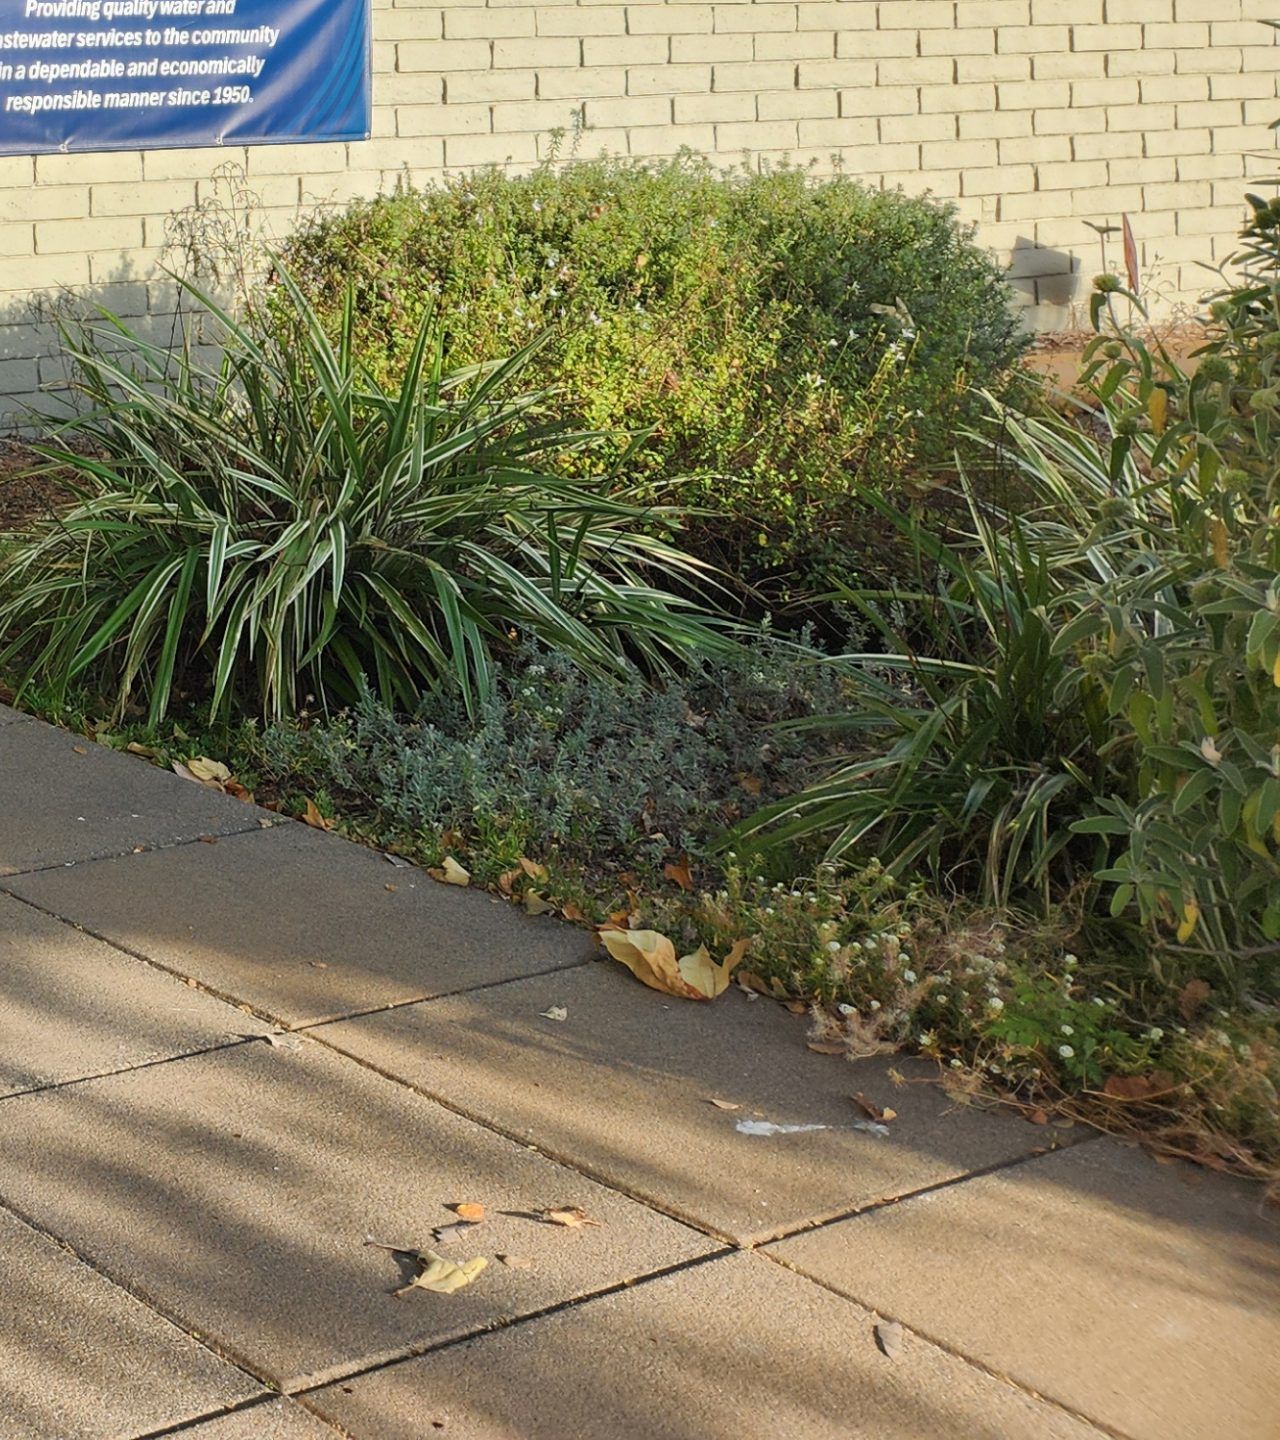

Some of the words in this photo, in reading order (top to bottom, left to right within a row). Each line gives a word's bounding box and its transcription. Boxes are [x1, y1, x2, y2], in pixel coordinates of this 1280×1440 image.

[76, 28, 142, 47] services
[145, 29, 161, 45] to
[164, 27, 189, 45] the
[191, 25, 280, 47] community
[15, 64, 26, 80] a
[28, 59, 125, 83] dependable
[127, 58, 159, 77] and
[160, 55, 266, 78] economically
[6, 90, 102, 115] responsible
[103, 91, 167, 108] manner
[167, 87, 211, 106] since
[212, 85, 254, 105] 1950.
